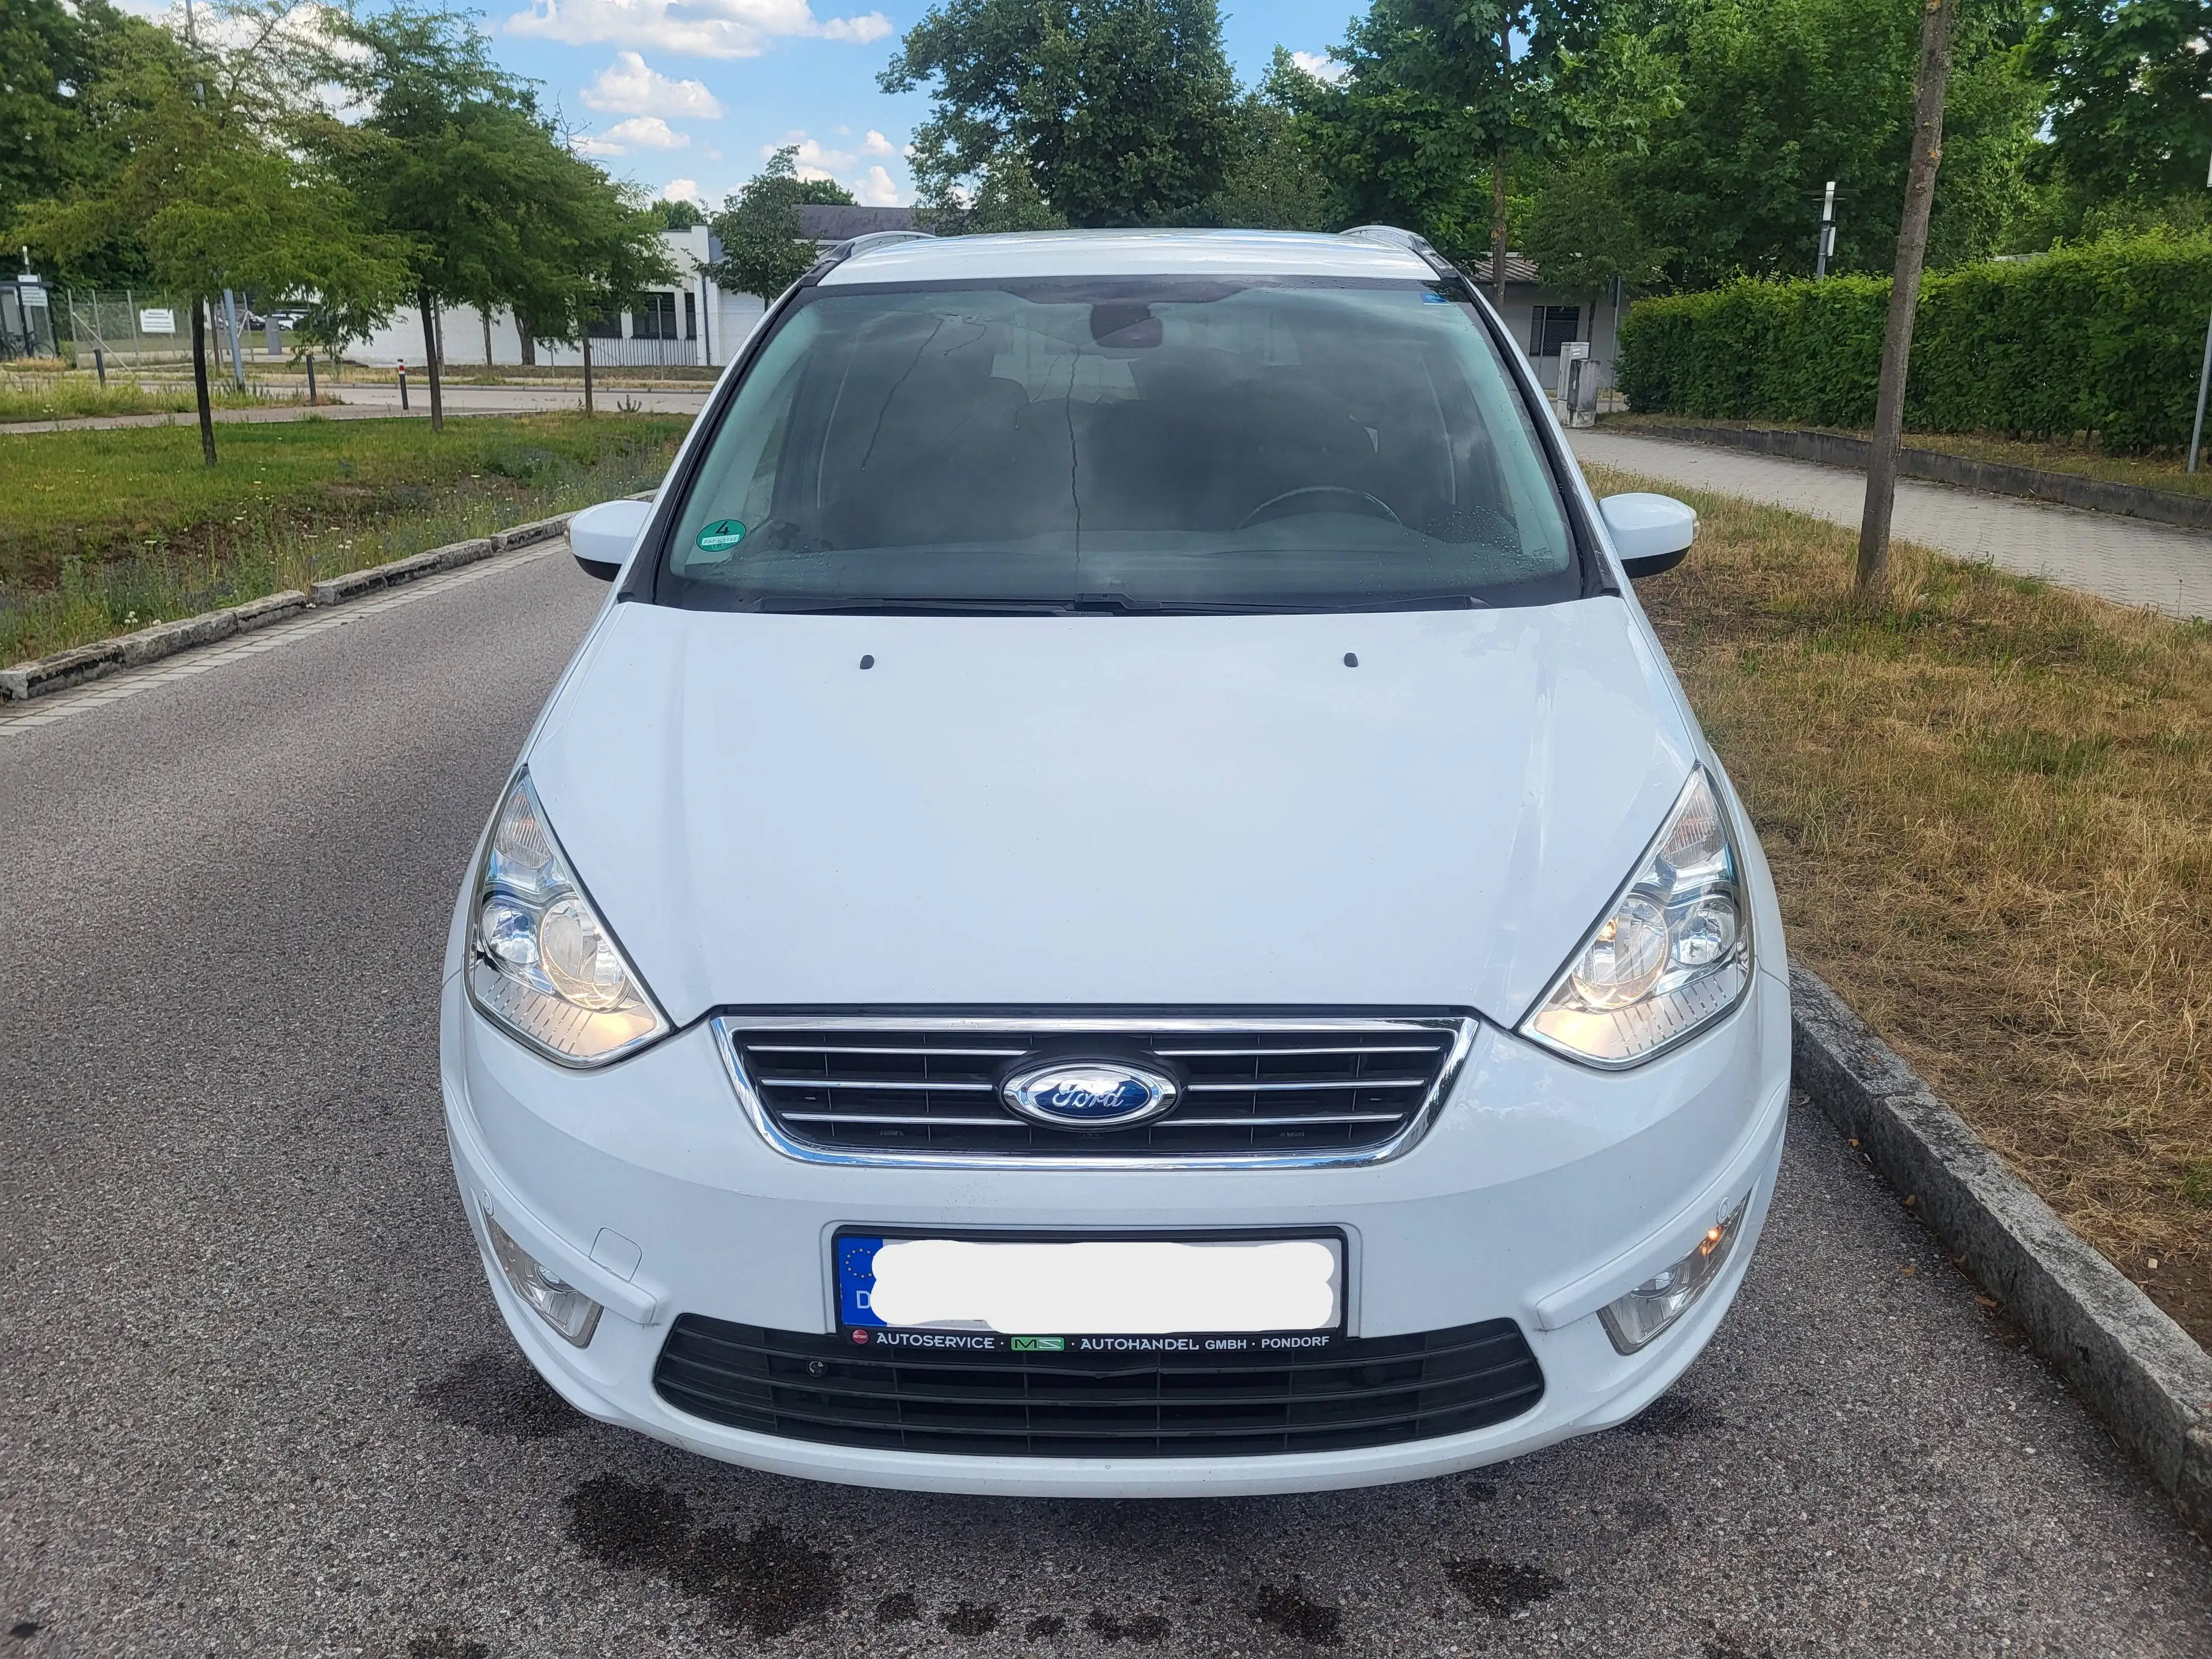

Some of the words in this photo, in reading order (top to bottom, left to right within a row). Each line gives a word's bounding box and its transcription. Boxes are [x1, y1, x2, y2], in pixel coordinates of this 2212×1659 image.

[715, 521, 729, 535] 4
[1052, 1079, 1126, 1108] Ford
[856, 1290, 872, 1309] D
[876, 1332, 995, 1349] AUTOSERVICE
[1080, 1338, 1199, 1350] AUTOHANDEL
[1205, 1339, 1247, 1350] GMBH
[1262, 1336, 1330, 1349] PONDORF
